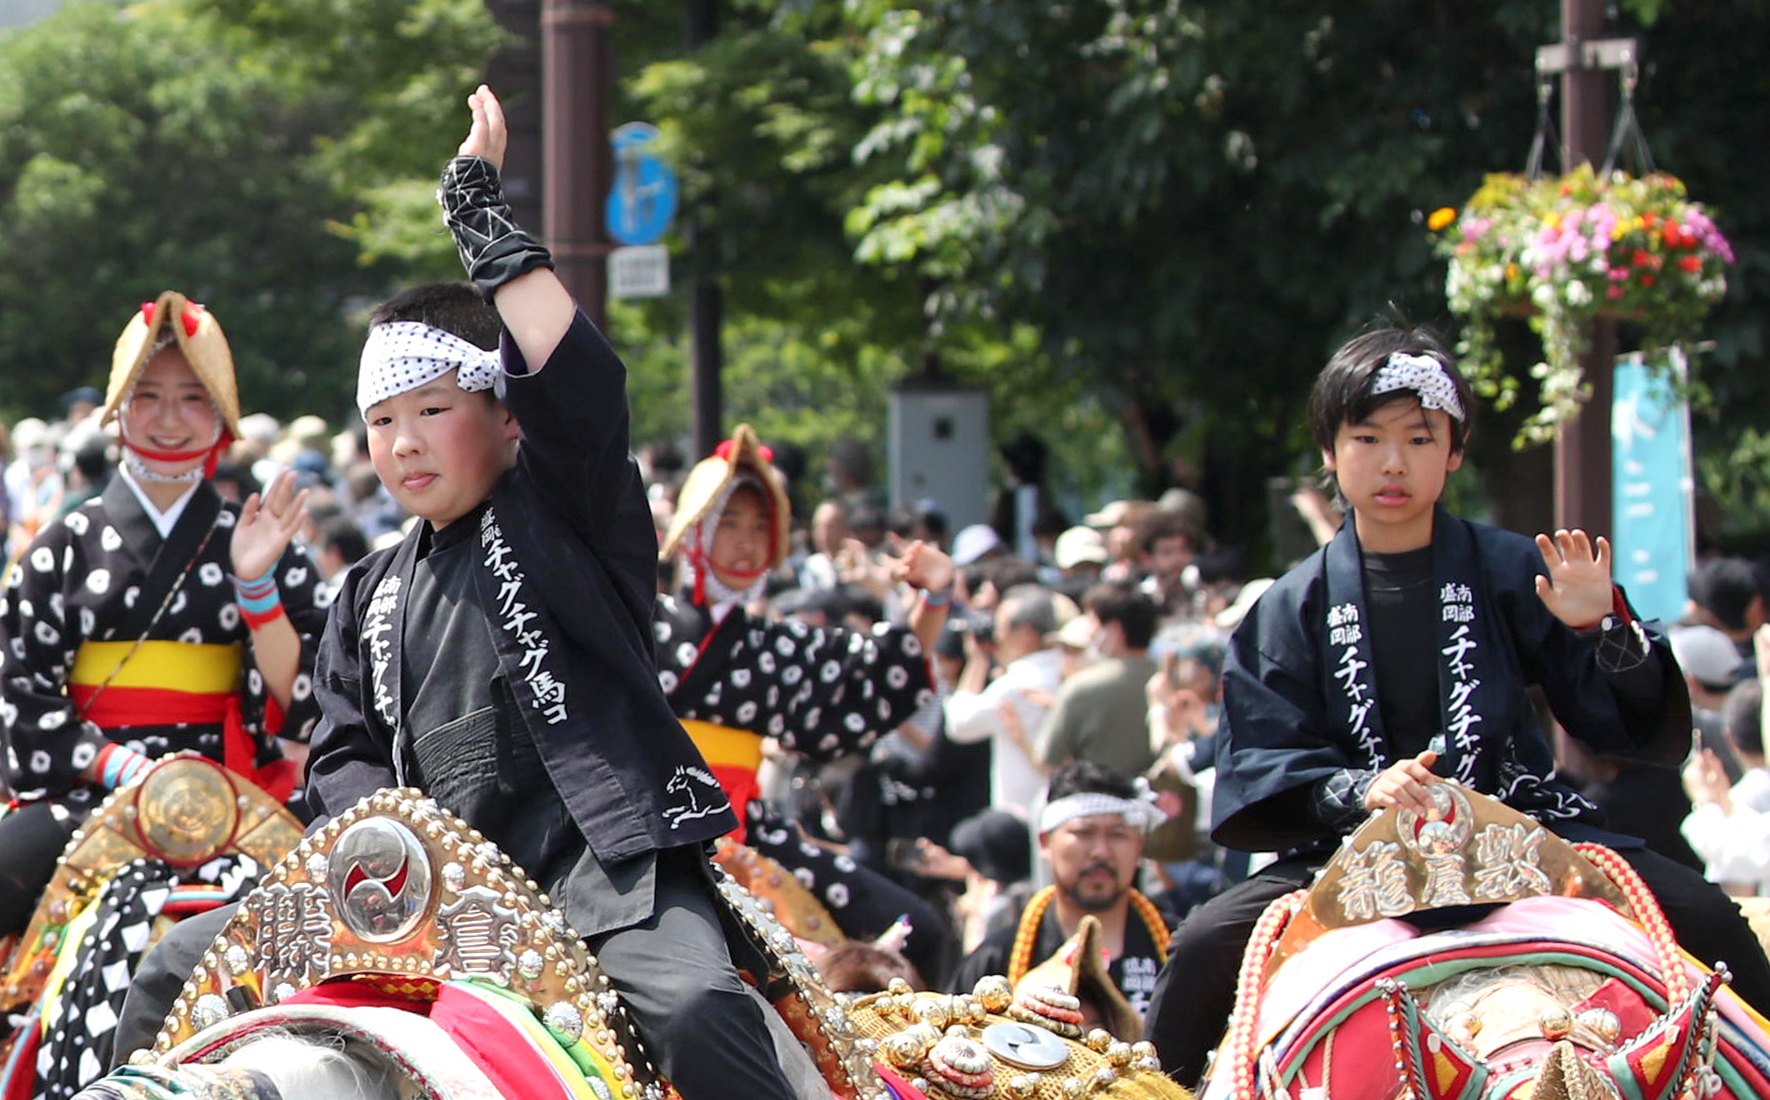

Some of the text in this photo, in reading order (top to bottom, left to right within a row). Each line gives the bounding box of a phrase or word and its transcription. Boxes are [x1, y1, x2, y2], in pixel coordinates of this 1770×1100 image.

[1341, 603, 1362, 643] 南部
[1439, 582, 1460, 623] 盛岡
[1456, 584, 1476, 622] 南部
[483, 539, 569, 725] チャグチャグ馬コ
[1327, 605, 1348, 646] 盛岡
